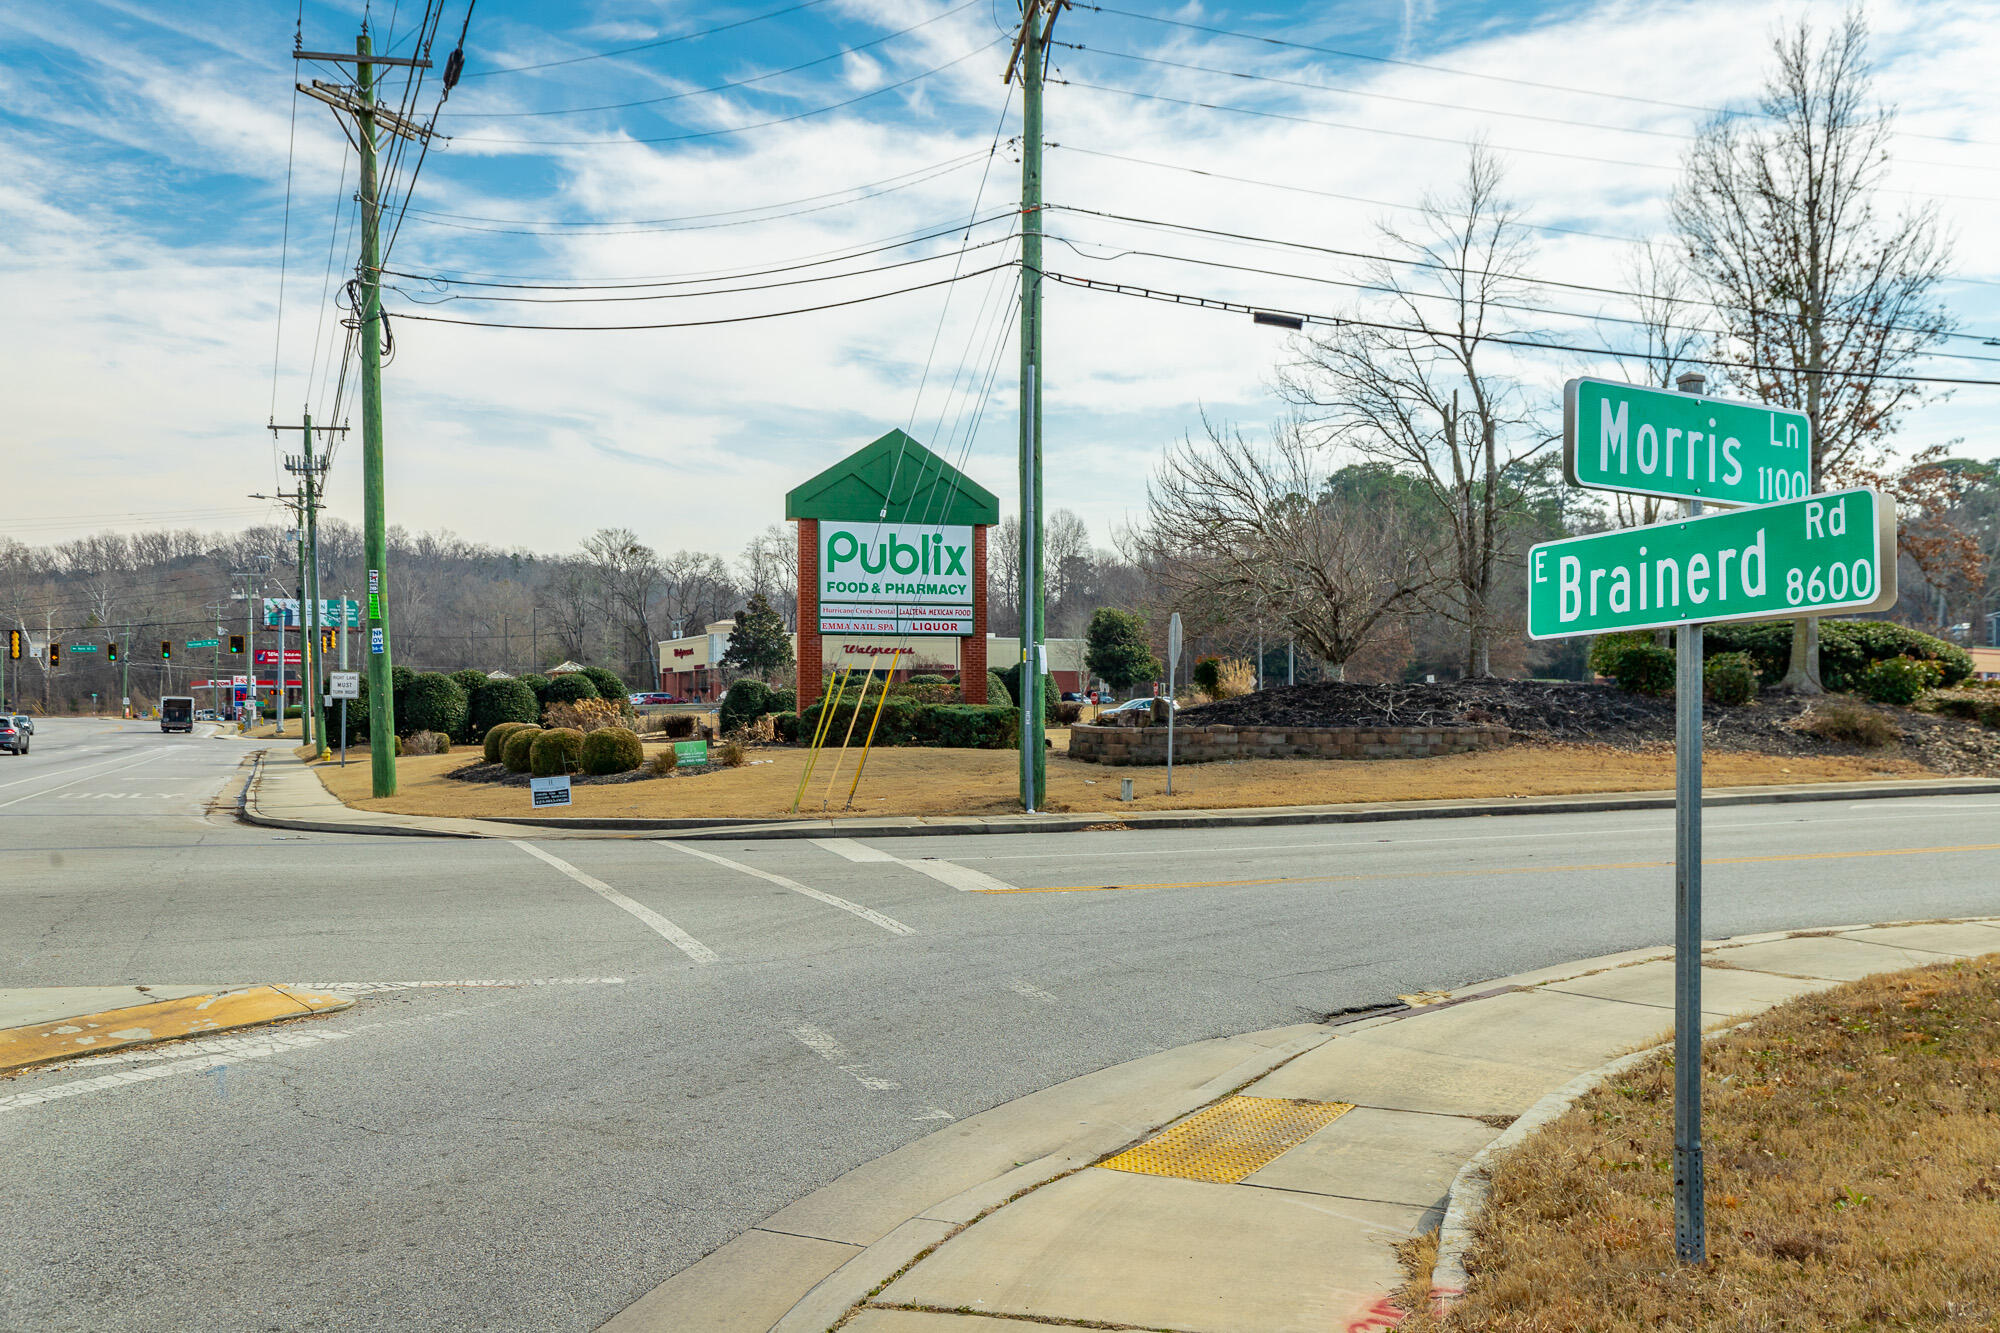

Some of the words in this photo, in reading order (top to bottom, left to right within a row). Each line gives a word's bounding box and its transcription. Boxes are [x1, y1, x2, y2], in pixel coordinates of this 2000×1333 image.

[1600, 397, 1743, 486] Morris
[1769, 412, 1799, 449] Ln
[1758, 466, 1807, 501] 1100
[1805, 497, 1847, 540] Rd
[827, 531, 966, 575] Publix
[1535, 551, 1548, 583] E
[1559, 528, 1766, 623] Brainerd
[1786, 557, 1872, 606] 8600
[827, 581, 869, 593] FOOD
[871, 583, 881, 594] &
[885, 583, 967, 595] PHARMACY
[875, 607, 896, 615] Dental
[853, 623, 876, 631] NAIL
[877, 623, 895, 631] SPA
[912, 622, 958, 632] LIQUOR
[843, 645, 915, 657] Walgreens
